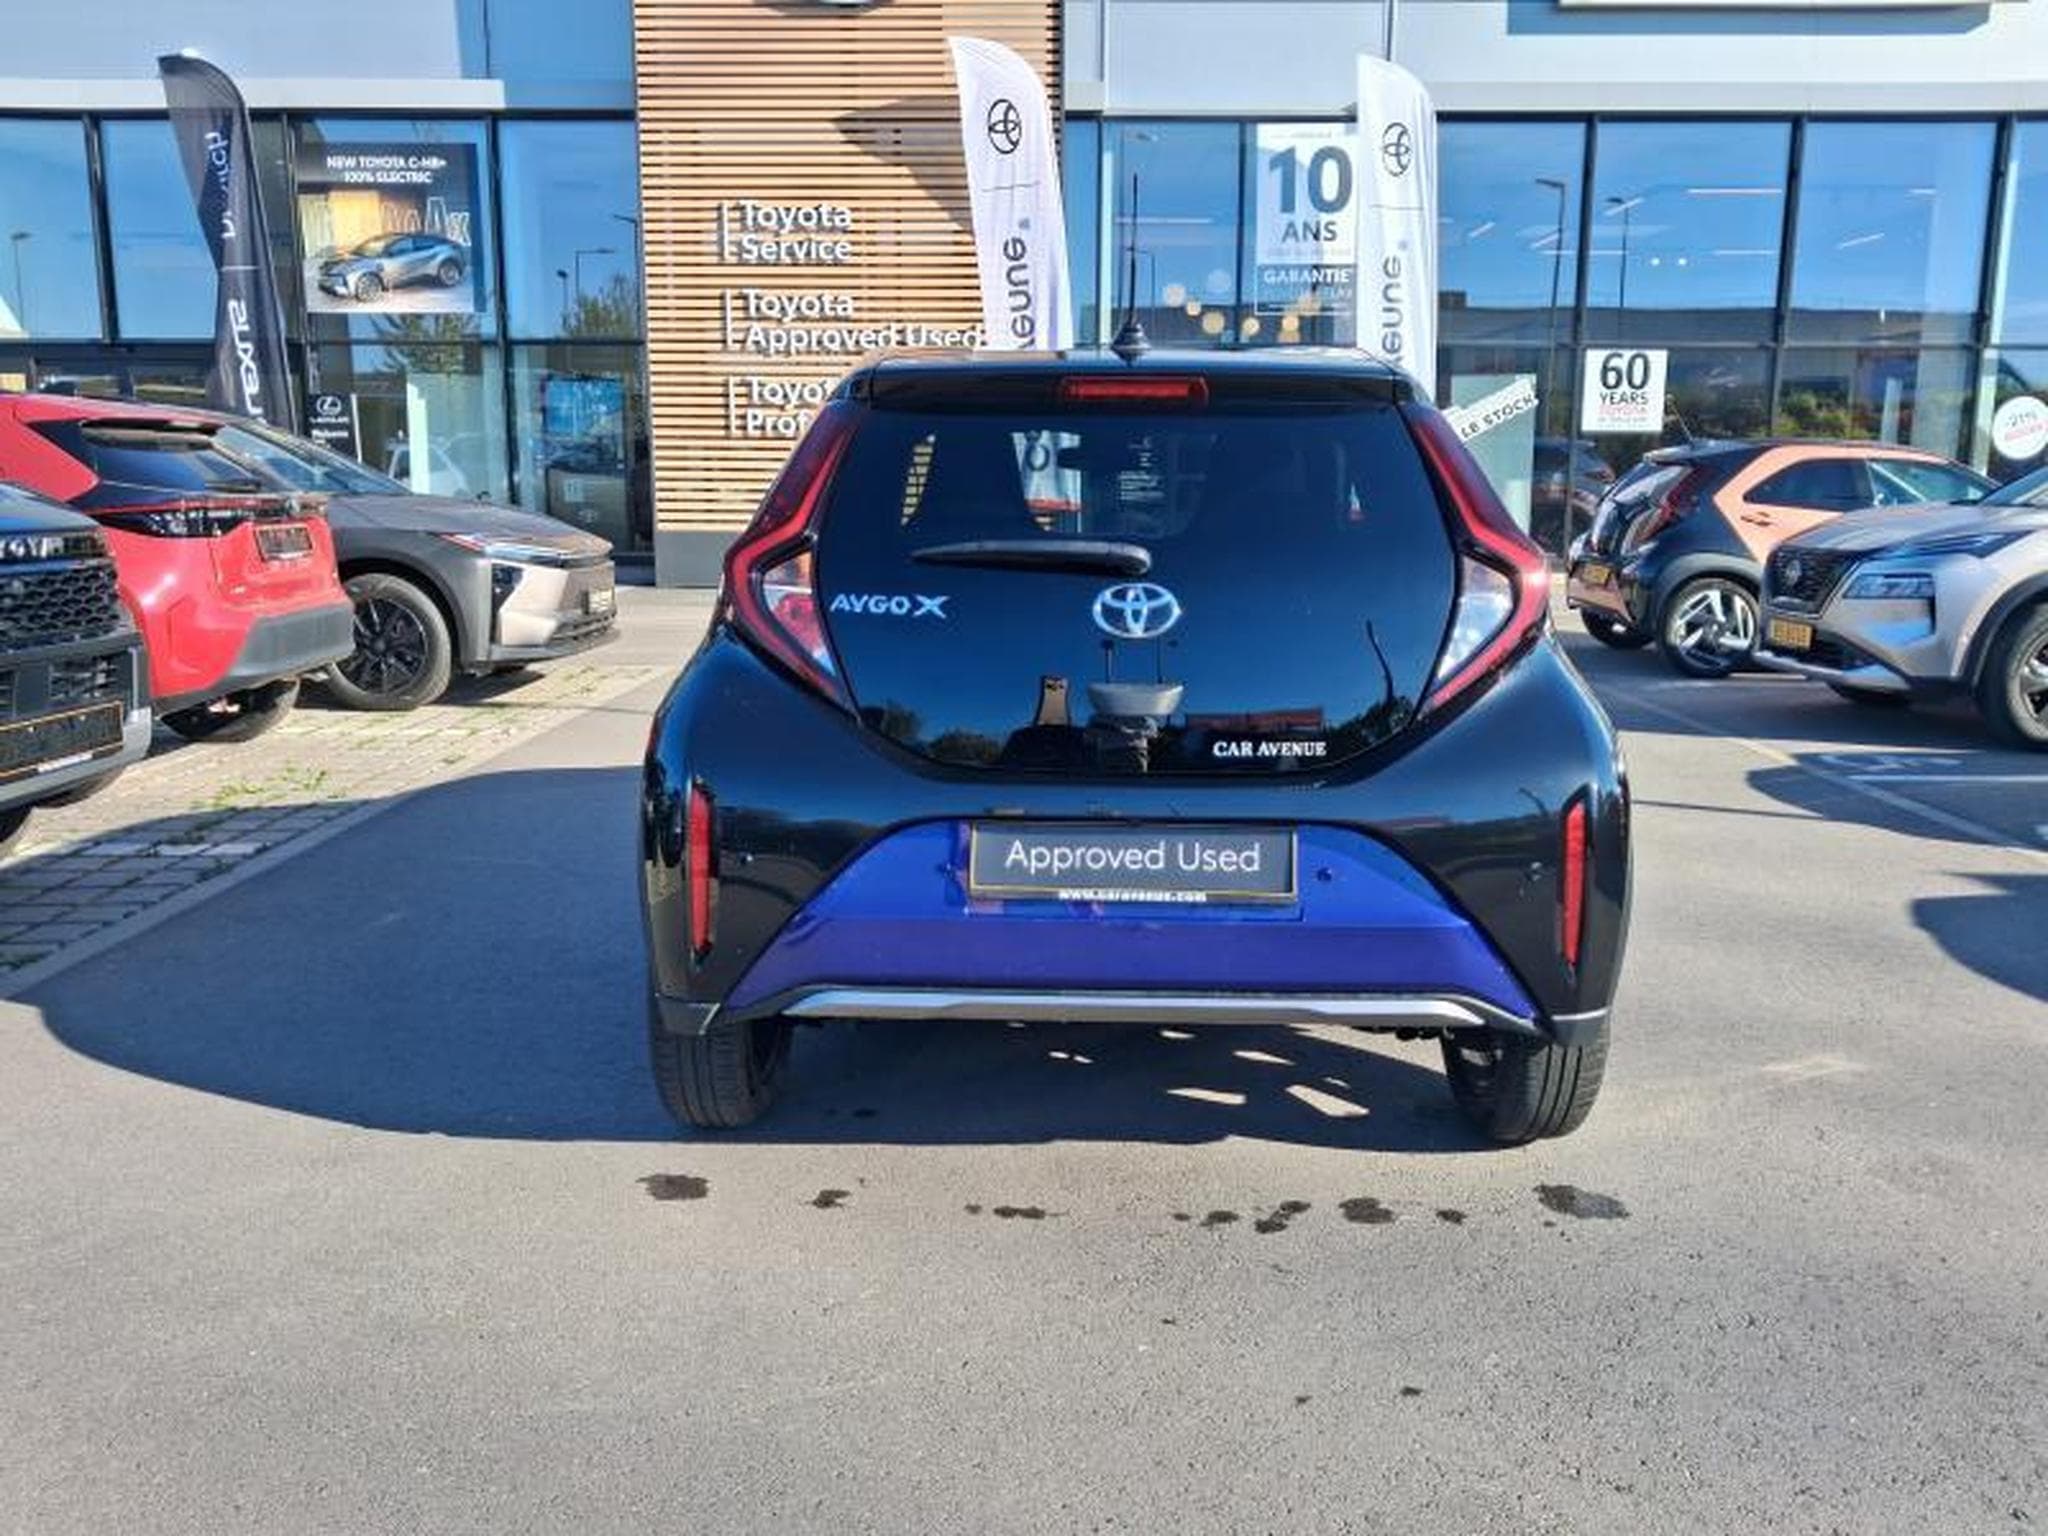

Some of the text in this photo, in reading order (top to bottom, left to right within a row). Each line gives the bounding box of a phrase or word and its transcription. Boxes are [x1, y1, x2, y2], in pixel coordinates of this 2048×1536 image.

[1268, 145, 1353, 214] 10
[740, 200, 852, 233] Toyota
[1281, 220, 1338, 243] ANS
[741, 234, 852, 261] Service
[1263, 269, 1350, 285] GARANTIE
[742, 290, 854, 322] Toyota
[747, 324, 981, 354] Approved Used
[1600, 352, 1650, 390] 60
[1600, 391, 1649, 405] YEARS
[829, 593, 911, 615] AYGO
[1213, 741, 1327, 757] CAR AVENUE
[1004, 839, 1261, 876] Approved Used
